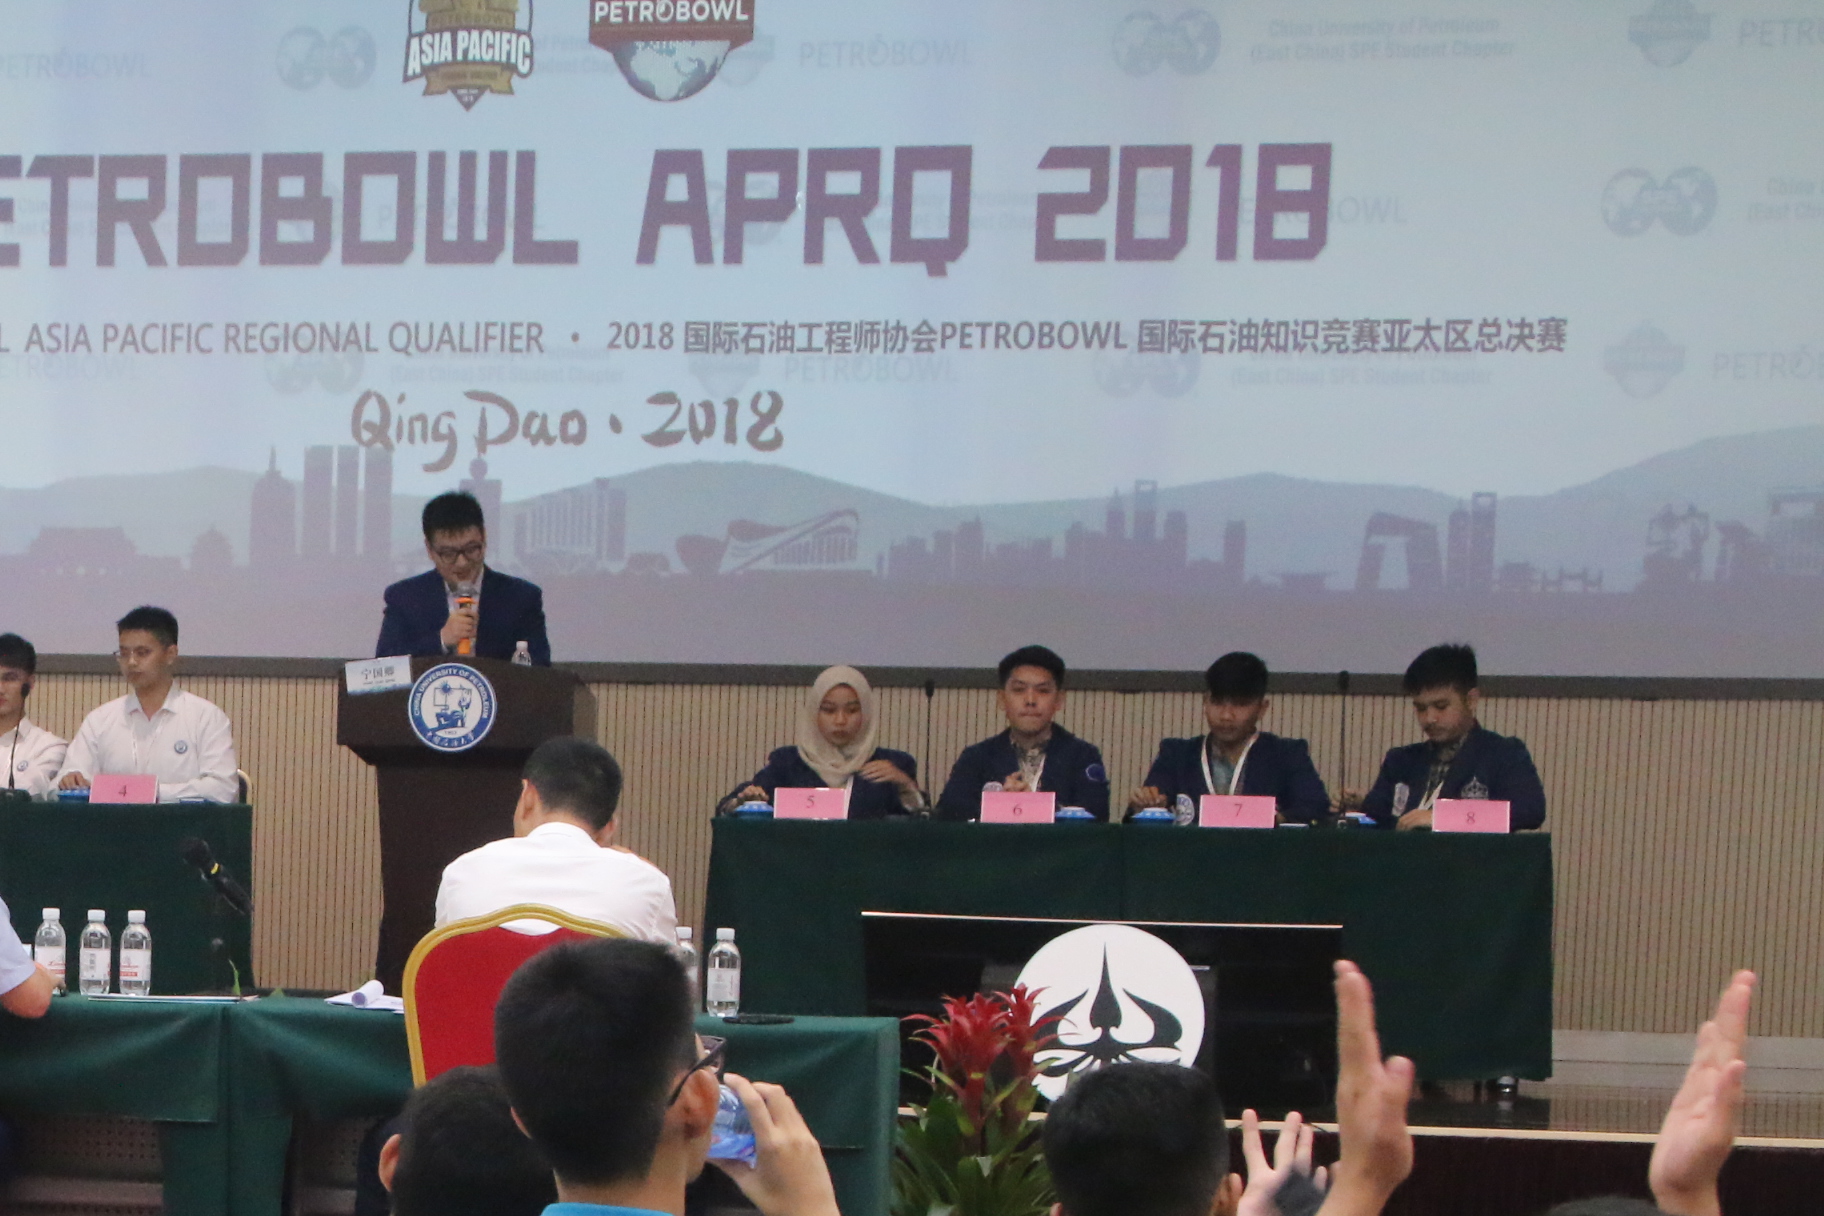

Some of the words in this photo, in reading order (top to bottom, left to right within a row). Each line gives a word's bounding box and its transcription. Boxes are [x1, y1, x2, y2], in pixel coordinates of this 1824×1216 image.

[593, 0, 750, 24] PETROBOWL
[1739, 18, 1824, 49] PETR
[407, 31, 453, 76] ASIA
[456, 29, 531, 75] PACIFIC
[636, 145, 973, 277] APRQ
[1035, 142, 1333, 262] 2018
[25, 322, 92, 354] ASIA
[102, 322, 213, 354] PACIFIC
[224, 321, 379, 354] REGIONAL
[388, 321, 545, 358] QUALIFIER
[607, 322, 674, 351] 2018
[1137, 316, 1568, 355] 国际石油知识竞赛亚太区总决赛
[1712, 344, 1824, 382] PETRO
[640, 390, 785, 453] 2018
[419, 668, 459, 693] UNIVERSITY
[118, 784, 128, 798] 4
[806, 794, 816, 809] 5
[1011, 803, 1023, 816] 6
[1233, 802, 1244, 817] 7
[1466, 811, 1477, 824] 8
